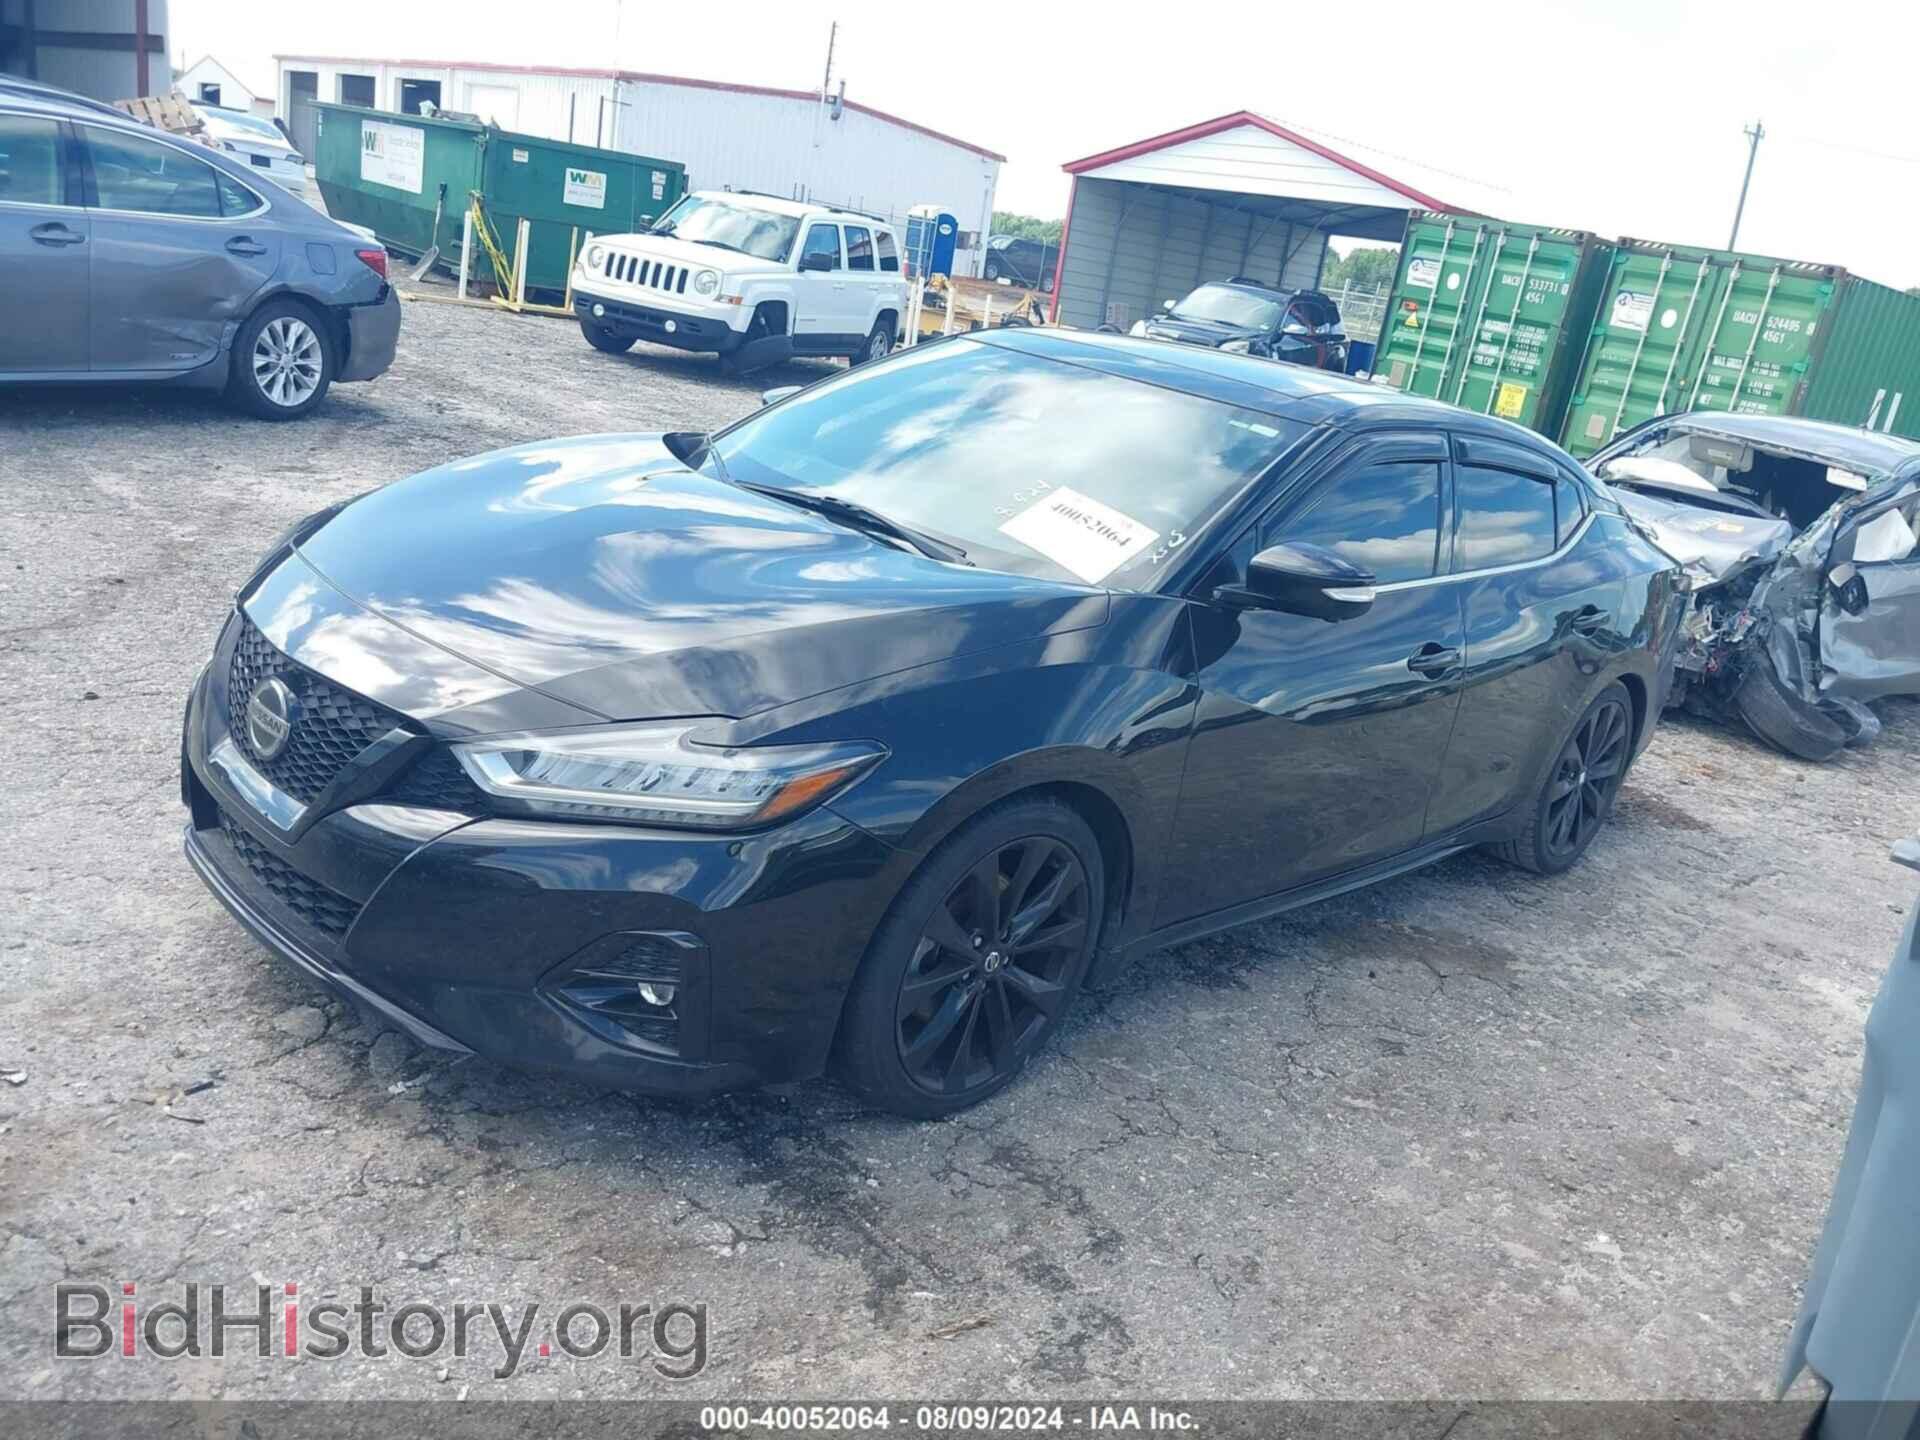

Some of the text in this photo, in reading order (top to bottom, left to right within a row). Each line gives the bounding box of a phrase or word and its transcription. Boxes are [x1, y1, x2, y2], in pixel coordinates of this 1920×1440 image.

[570, 171, 602, 186] WM
[1529, 278, 1558, 293] 533731
[1525, 292, 1545, 304] 45G1
[1766, 316, 1800, 332] 524495
[1762, 330, 1785, 344] 45G1
